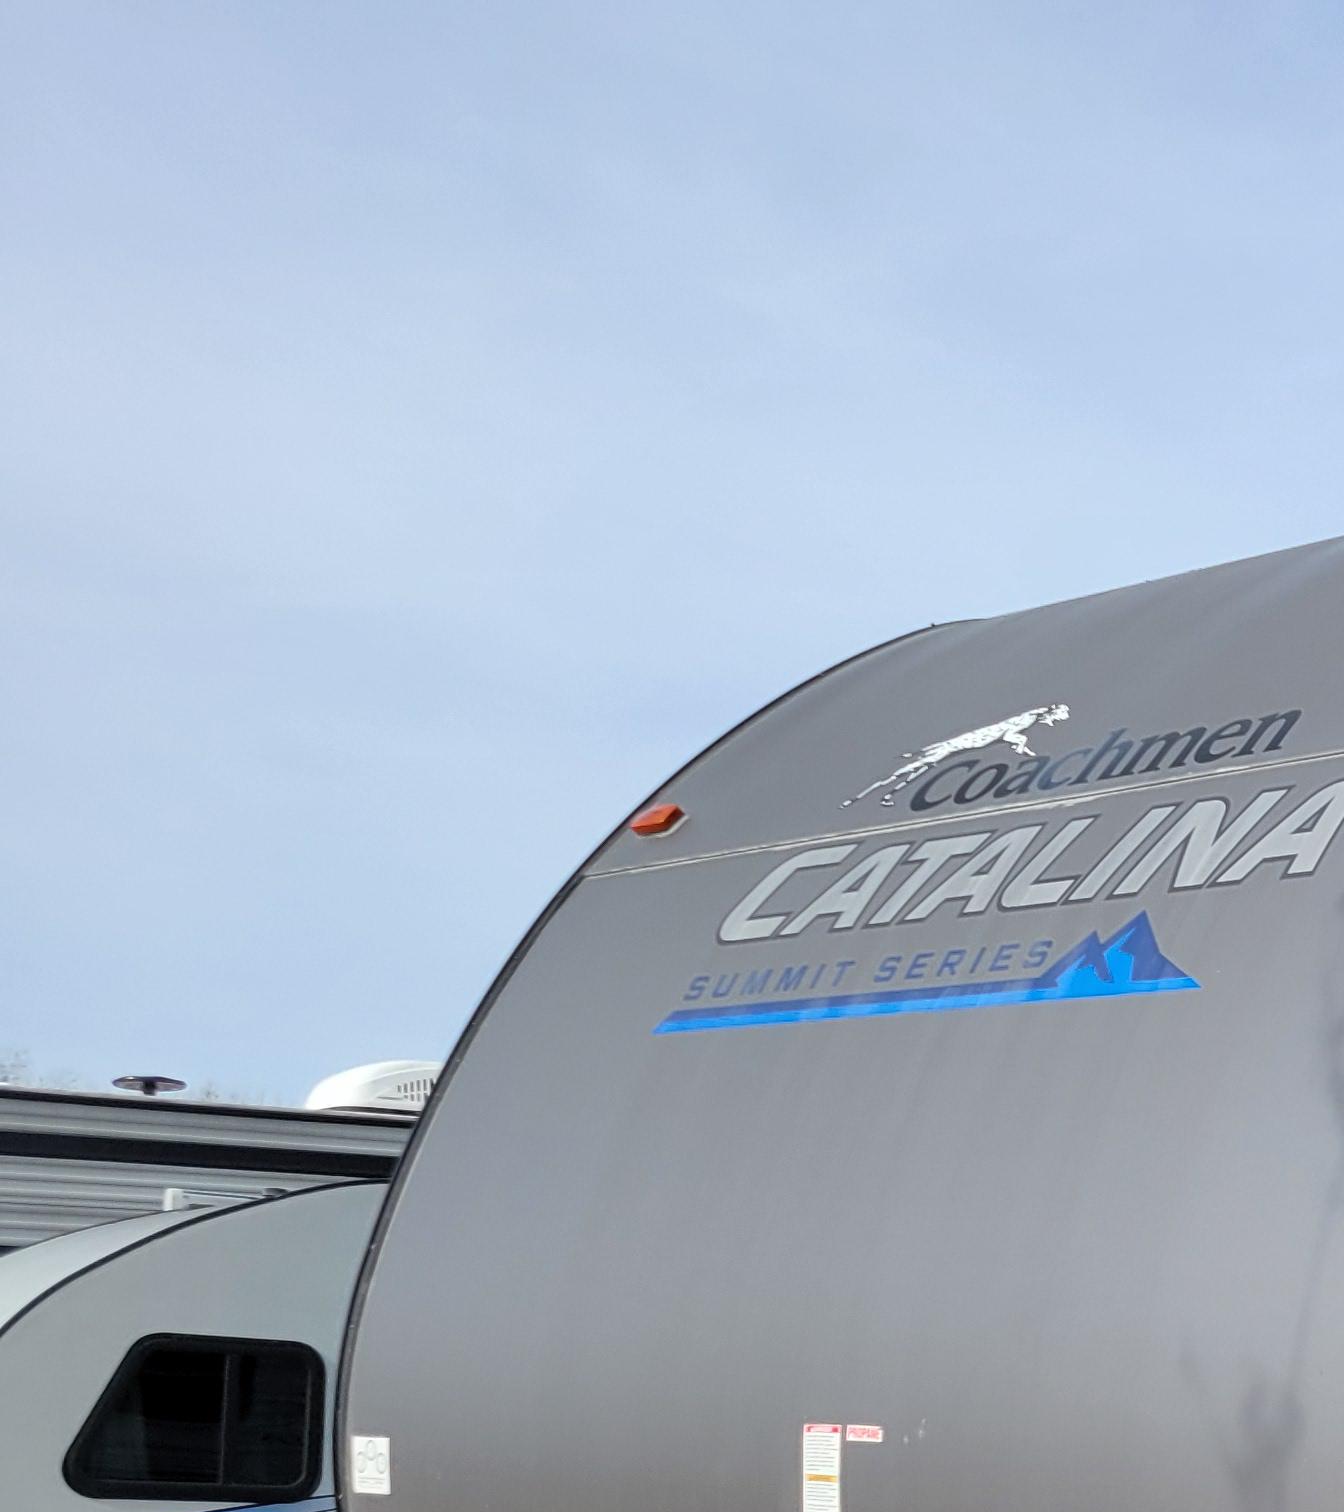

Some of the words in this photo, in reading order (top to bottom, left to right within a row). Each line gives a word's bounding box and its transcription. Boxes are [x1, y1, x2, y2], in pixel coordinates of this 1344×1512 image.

[909, 709, 1302, 811] Coachmen
[683, 960, 856, 1001] SUMMIT
[873, 940, 1054, 984] SERIES
